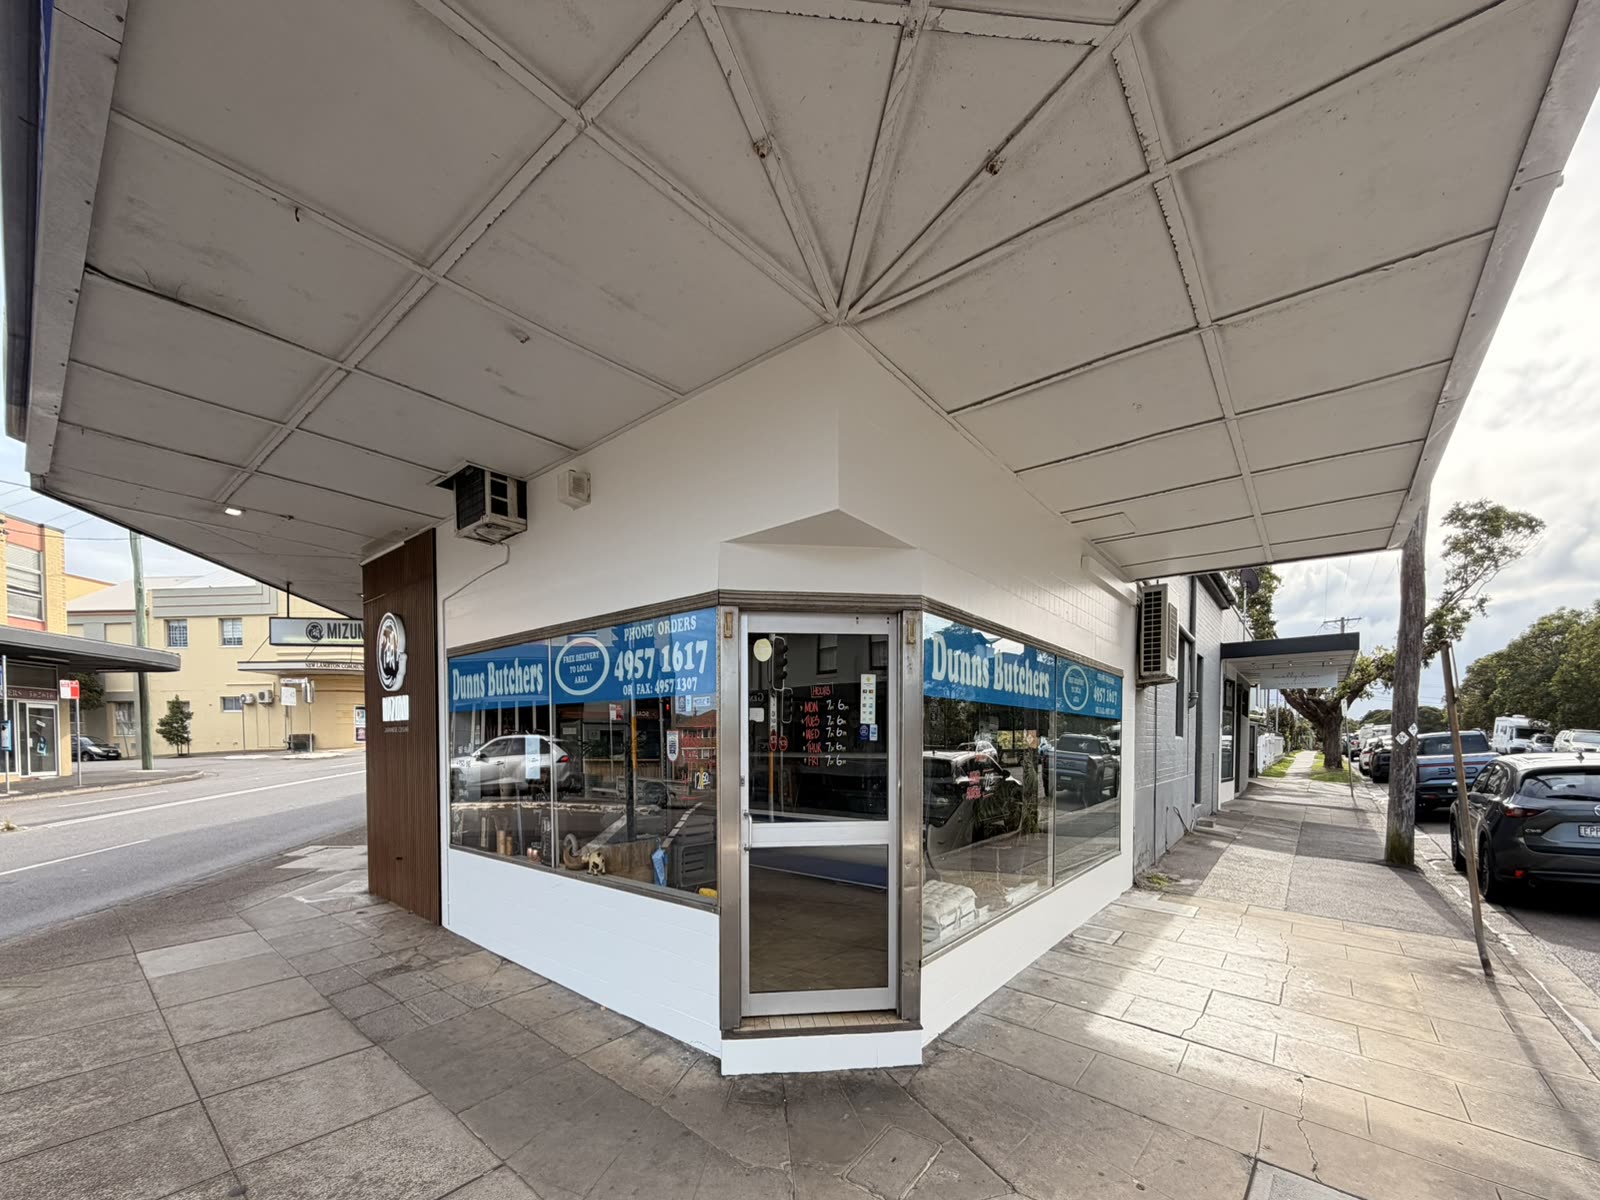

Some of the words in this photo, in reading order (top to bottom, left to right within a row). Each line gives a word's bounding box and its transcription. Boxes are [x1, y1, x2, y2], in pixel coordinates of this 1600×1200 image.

[624, 624, 654, 641] PHONE
[657, 615, 697, 635] ORDERS
[563, 655, 575, 664] FREE
[576, 651, 600, 662] DELIVERY
[569, 665, 576, 674] TO
[577, 663, 593, 673] LOCAL
[614, 647, 656, 682] 4957
[661, 640, 708, 674] 1617
[931, 633, 989, 688] Dunns
[994, 653, 1050, 698] Butchers
[452, 669, 485, 700] Dunns
[487, 657, 544, 697] Butchers
[574, 675, 588, 684] AREA
[622, 684, 633, 695] OR
[636, 683, 653, 695] FAX:
[654, 679, 675, 694] 4957
[676, 676, 698, 692] 1307
